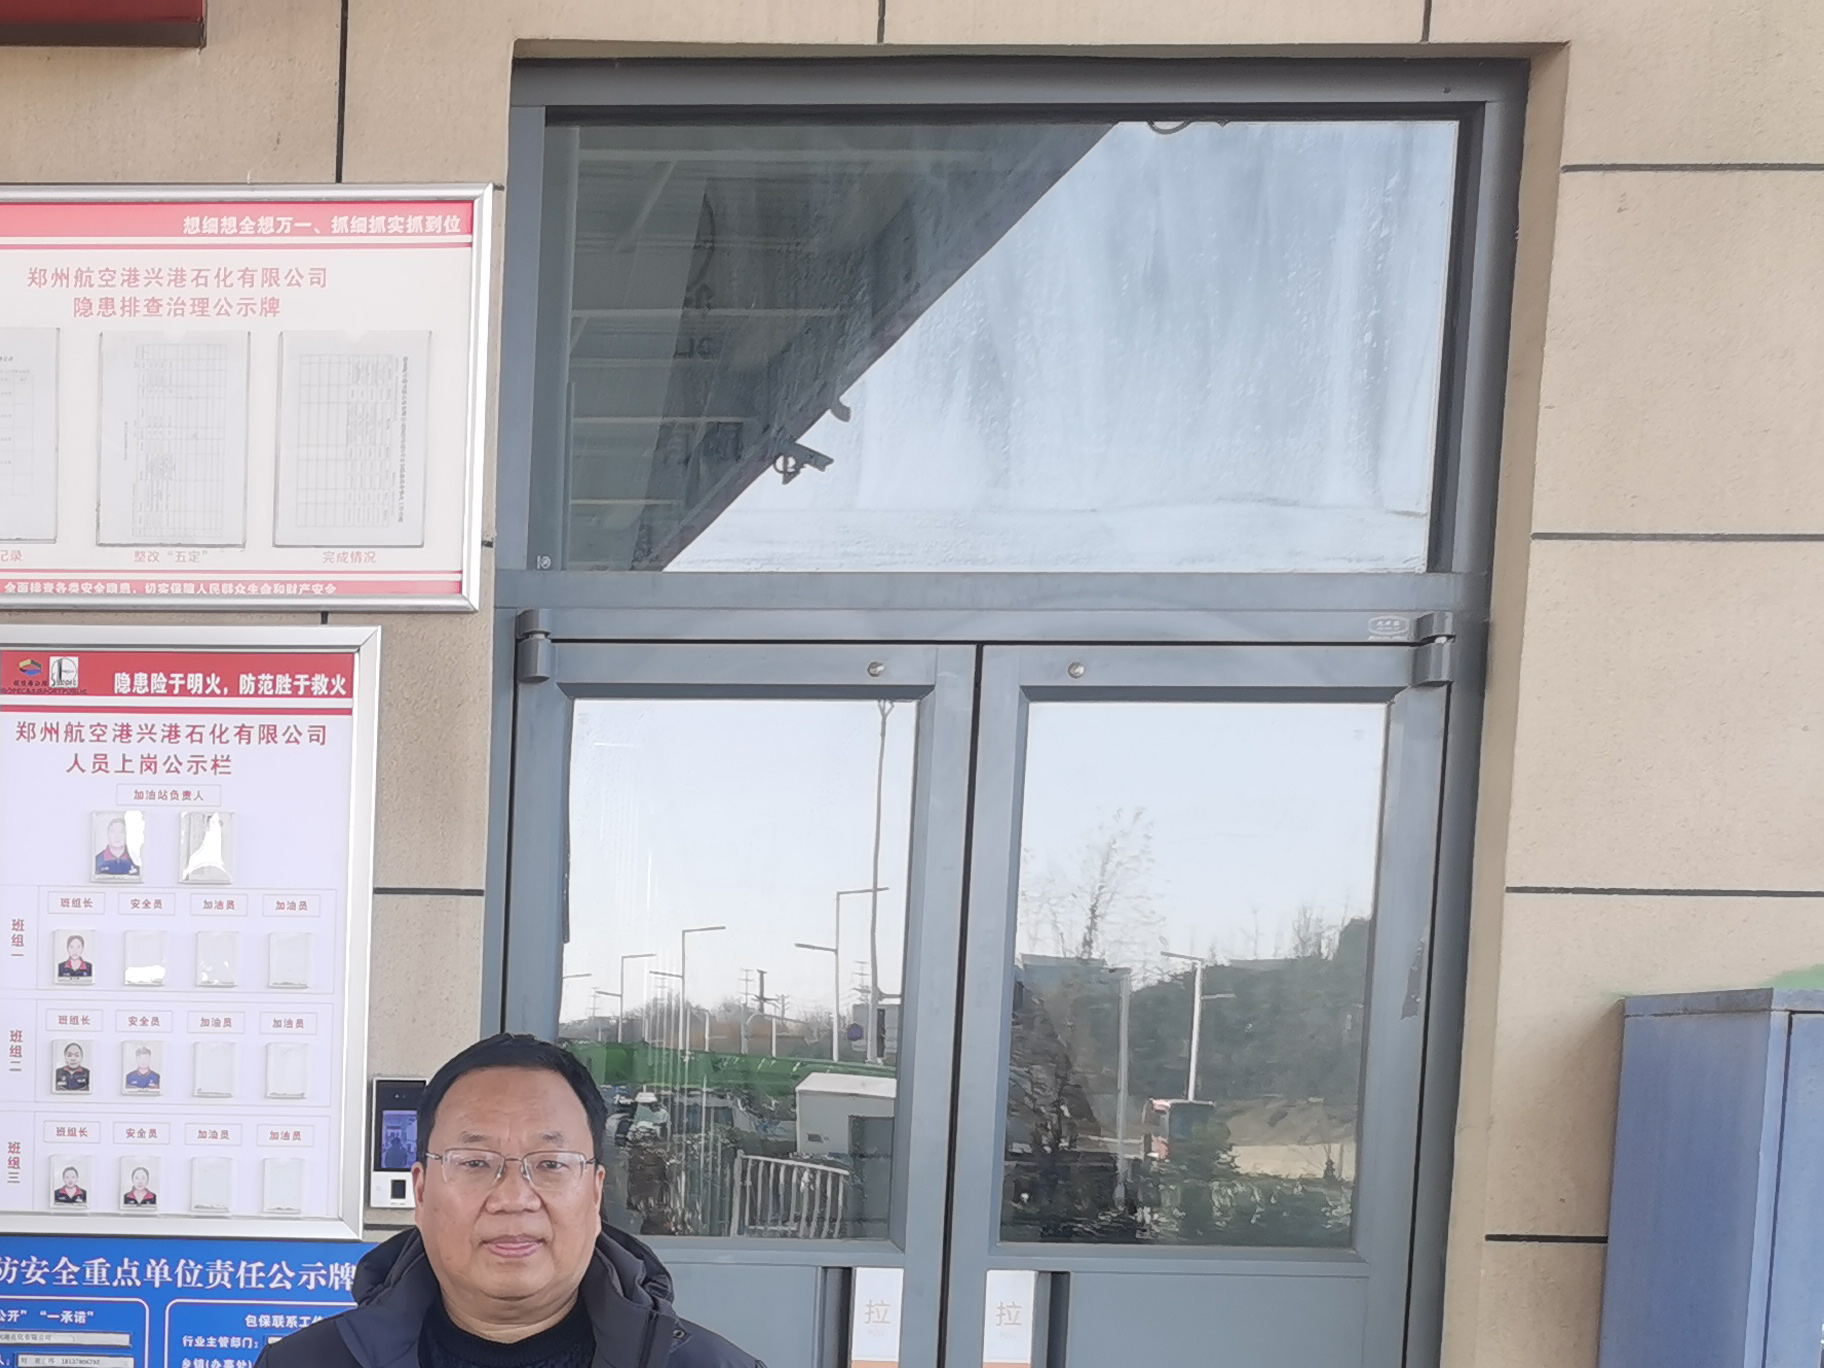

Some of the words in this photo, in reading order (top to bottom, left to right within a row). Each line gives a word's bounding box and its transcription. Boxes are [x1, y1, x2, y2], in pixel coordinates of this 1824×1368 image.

[182, 216, 462, 235] 想细想全想万一、抓细抓实抓到位
[27, 266, 328, 289] 郑州航空港兴港石化有限公司
[73, 297, 282, 318] 隐患排查治理公示牌
[322, 550, 378, 564] 完成情况
[114, 673, 347, 695] 隐患险于明火，防范胜于救火
[15, 722, 329, 746] 郑州航空港兴港石化有限公司
[66, 753, 233, 776] 人员上岗公示栏
[133, 789, 205, 802] 加油站负责人
[60, 897, 94, 910] 班组长
[130, 898, 163, 911] 安全员
[203, 899, 236, 912] 加油员
[275, 900, 309, 912] 加油员
[11, 918, 25, 958] 班组一
[58, 1014, 91, 1027] 班组长
[128, 1015, 161, 1028] 安全员
[200, 1016, 233, 1029] 加油员
[272, 1017, 305, 1030] 加油员
[8, 1029, 23, 1072] 班组二
[56, 1126, 88, 1138] 班组长
[125, 1127, 158, 1139] 安全员
[197, 1129, 230, 1141] 加油员
[269, 1129, 302, 1142] 加油员
[7, 1141, 21, 1184] 班组三
[864, 1299, 891, 1325] 拉
[996, 1301, 1023, 1327] 拉
